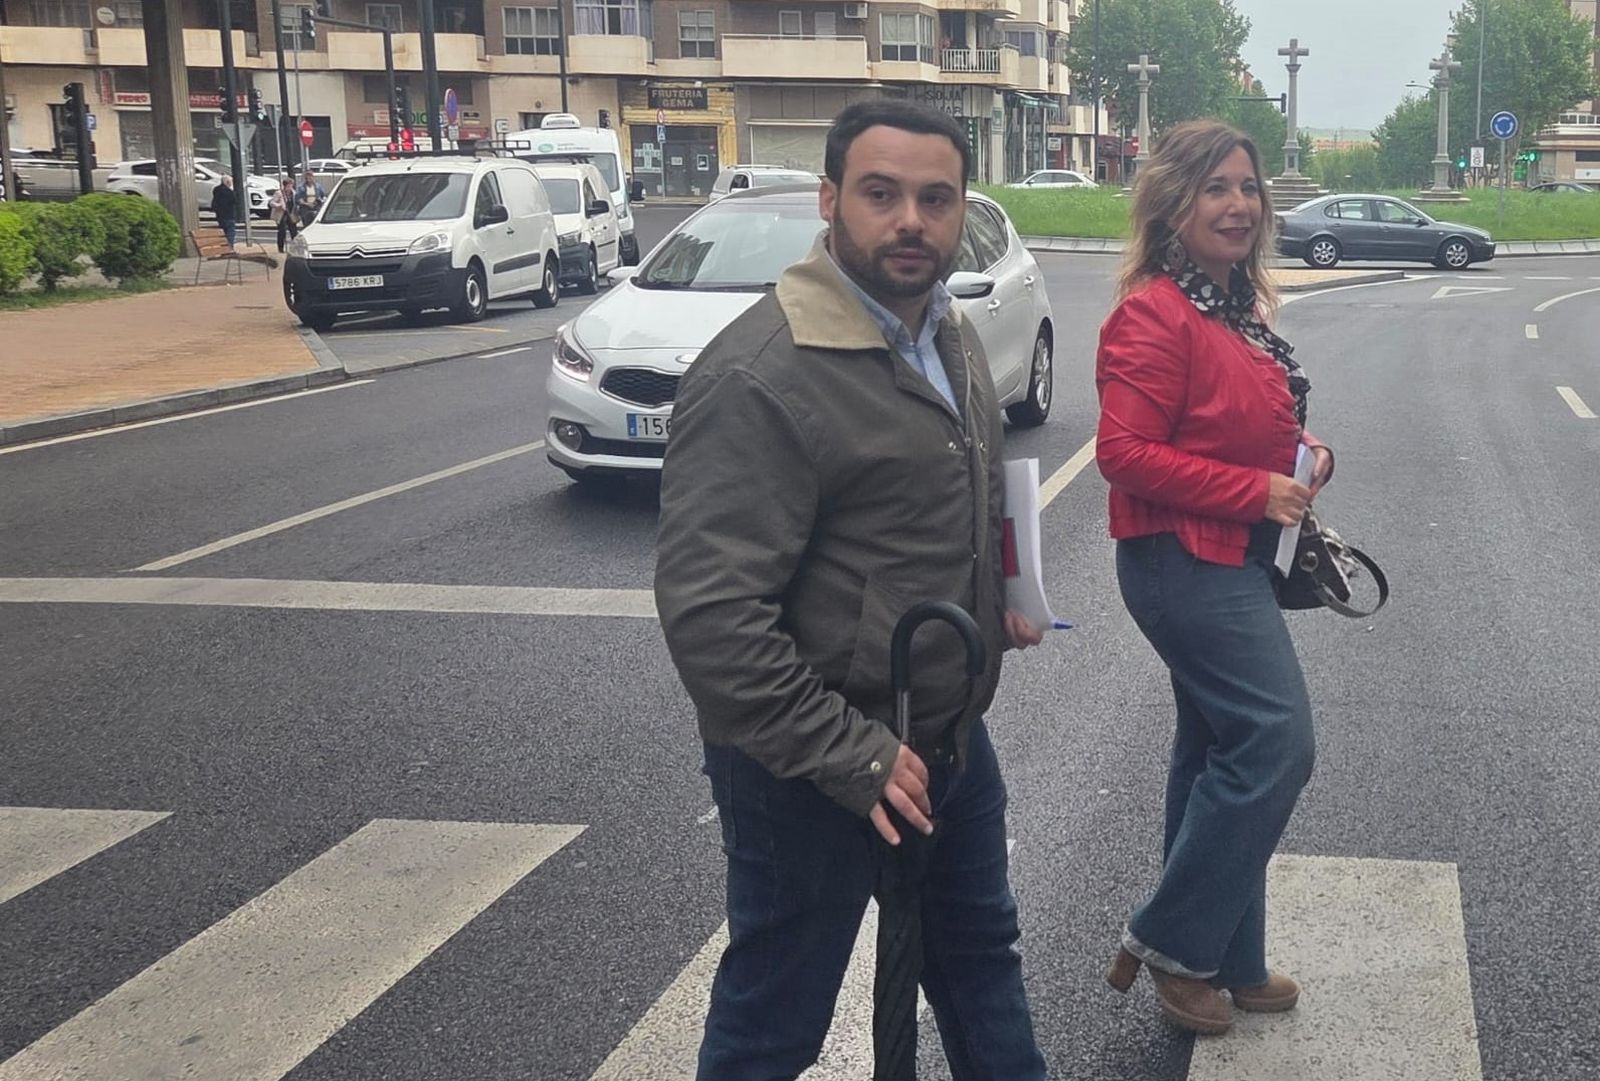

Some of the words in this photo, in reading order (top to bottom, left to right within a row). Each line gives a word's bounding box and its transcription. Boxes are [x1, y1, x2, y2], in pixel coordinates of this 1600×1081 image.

[651, 89, 703, 98] FRUTERIA
[662, 99, 694, 107] GEMA
[336, 278, 360, 288] 5786
